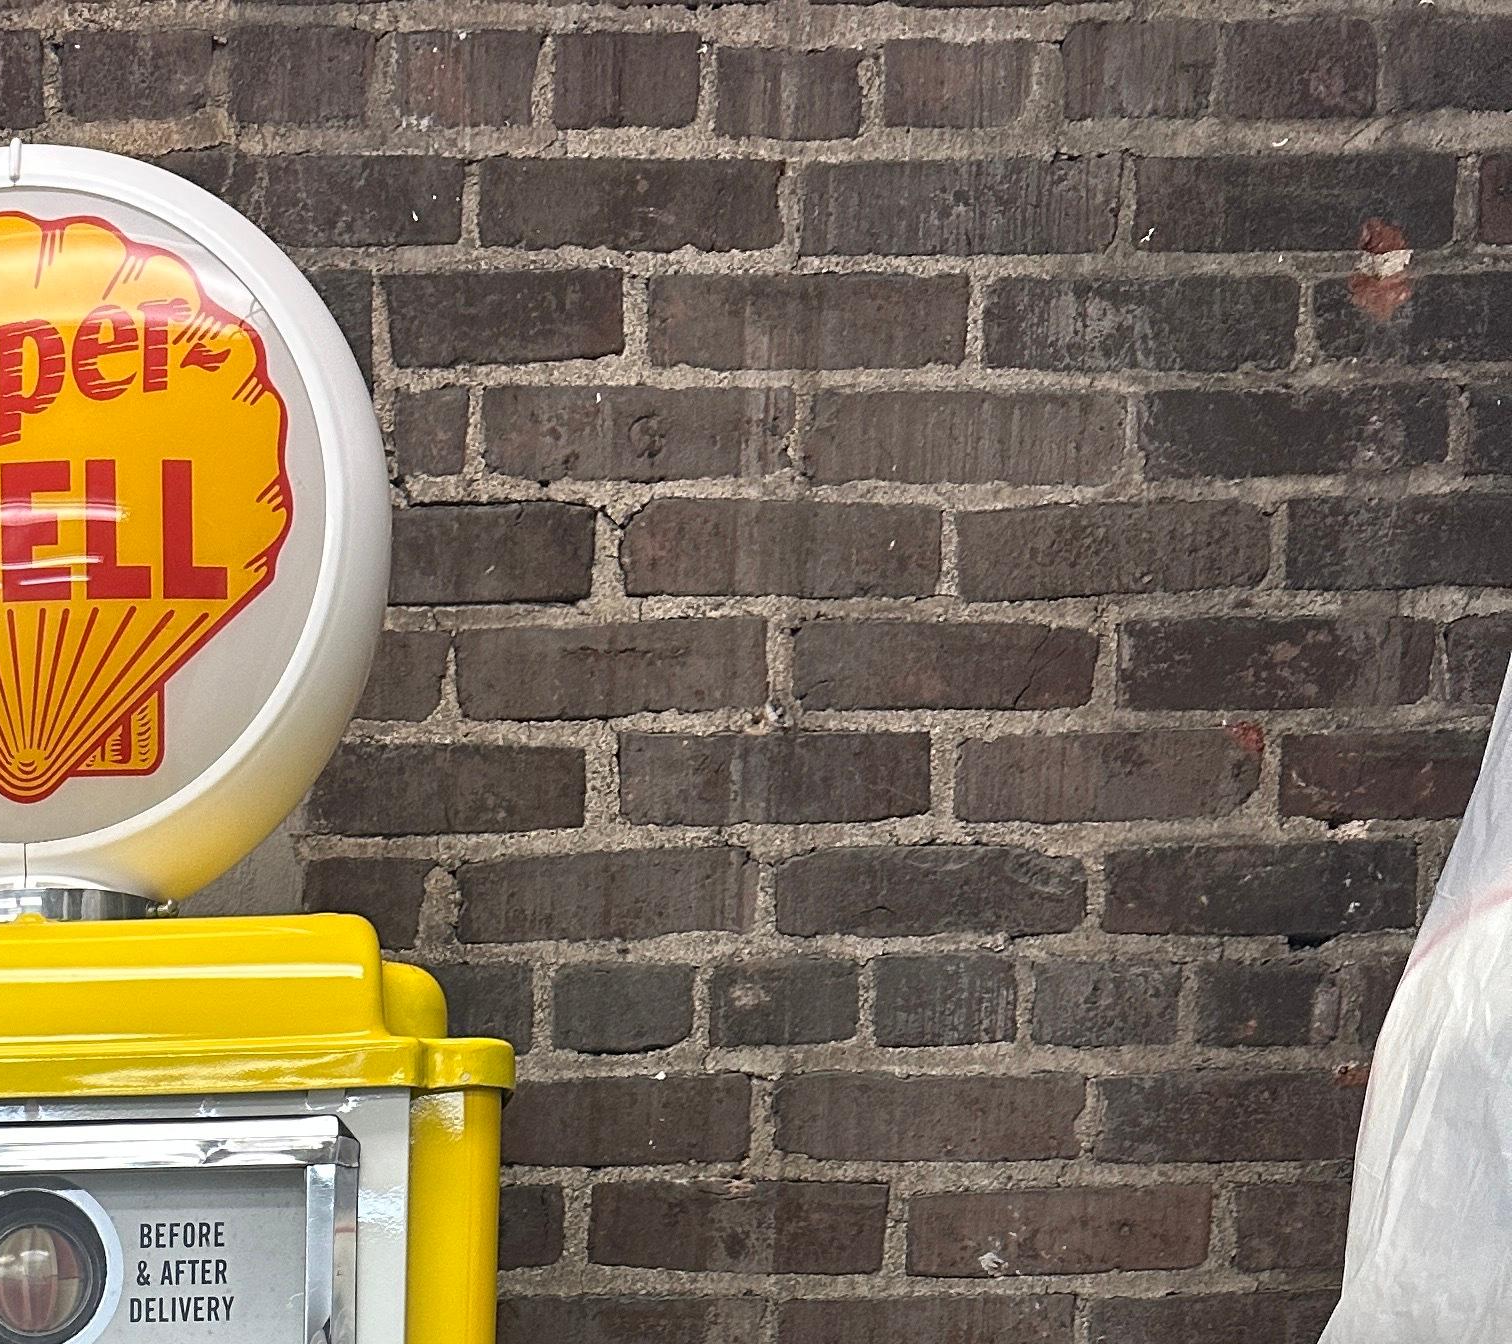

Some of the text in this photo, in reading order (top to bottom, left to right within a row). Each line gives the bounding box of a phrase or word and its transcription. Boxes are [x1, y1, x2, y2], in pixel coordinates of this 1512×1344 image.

[139, 1221, 225, 1249] BEFORE
[136, 1259, 228, 1287] & AFTER
[129, 1295, 235, 1323] DELIVERY
